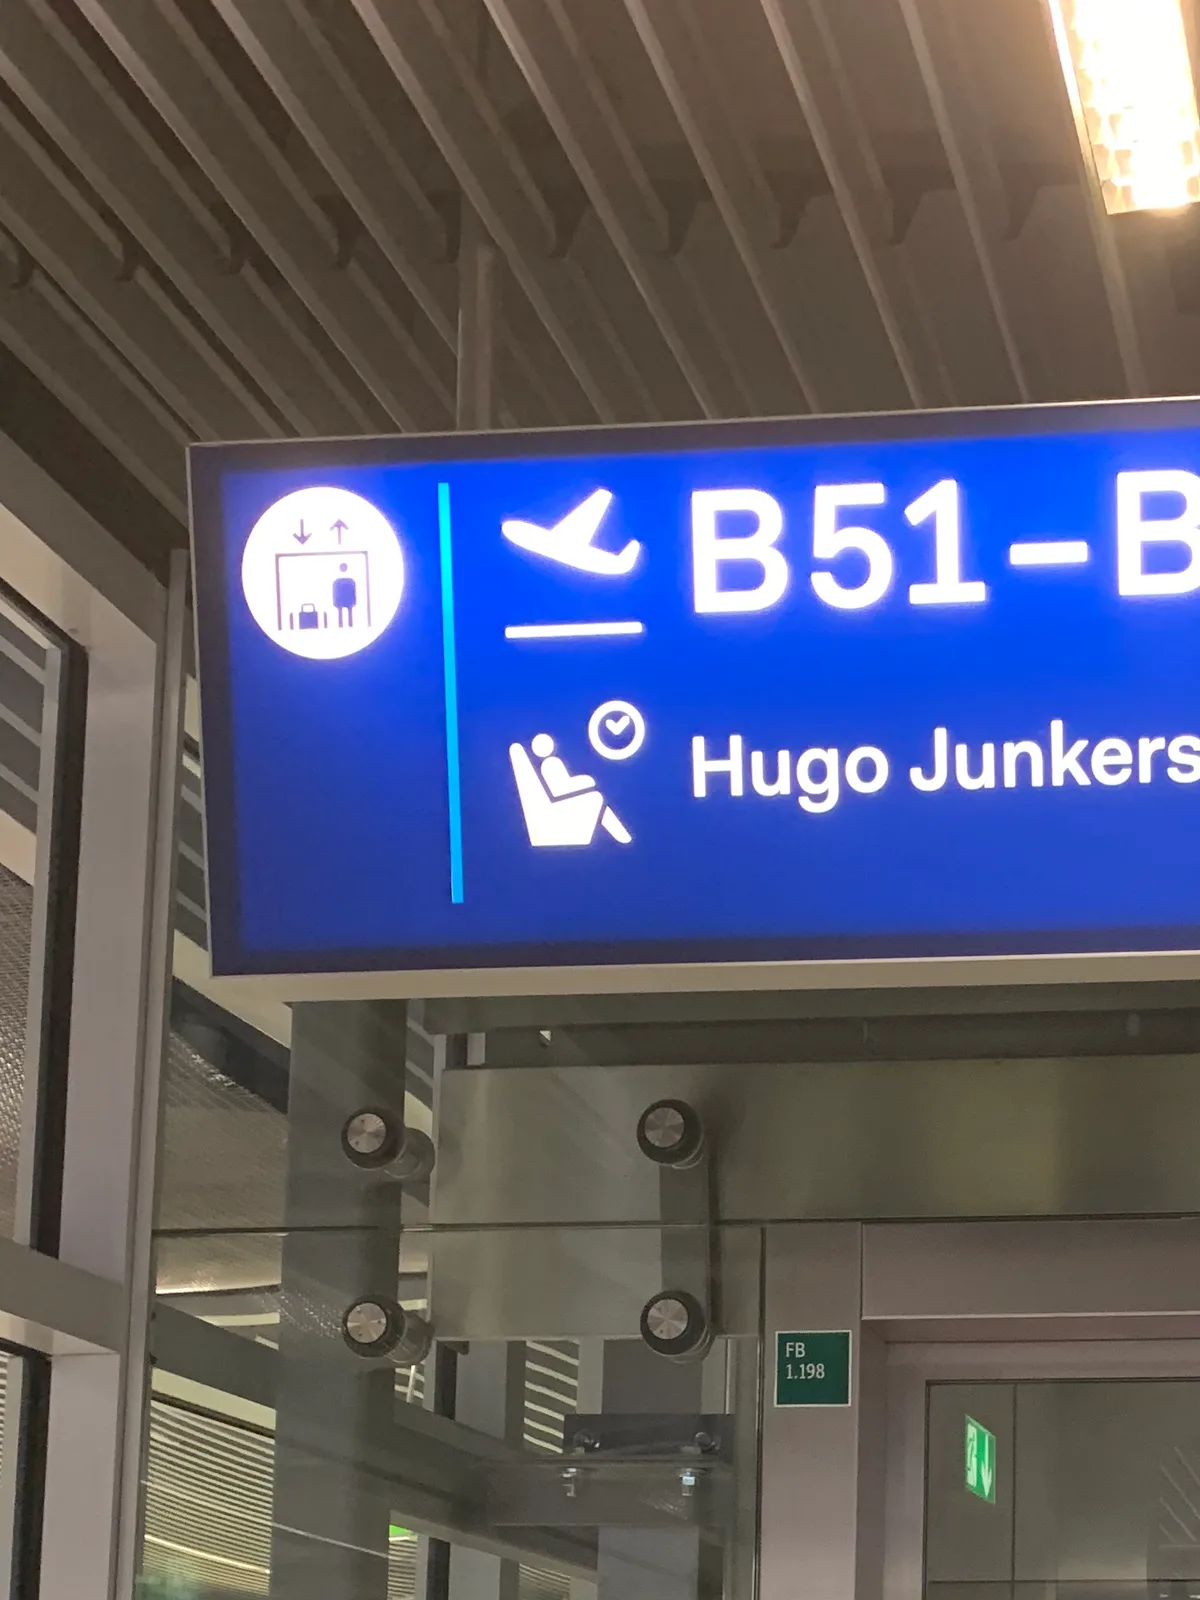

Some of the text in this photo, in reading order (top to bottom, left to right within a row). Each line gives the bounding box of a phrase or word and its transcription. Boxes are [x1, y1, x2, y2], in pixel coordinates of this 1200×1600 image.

[691, 734, 889, 814] Hugo
[785, 1342, 806, 1358] FB
[785, 1363, 826, 1380] 1.198
